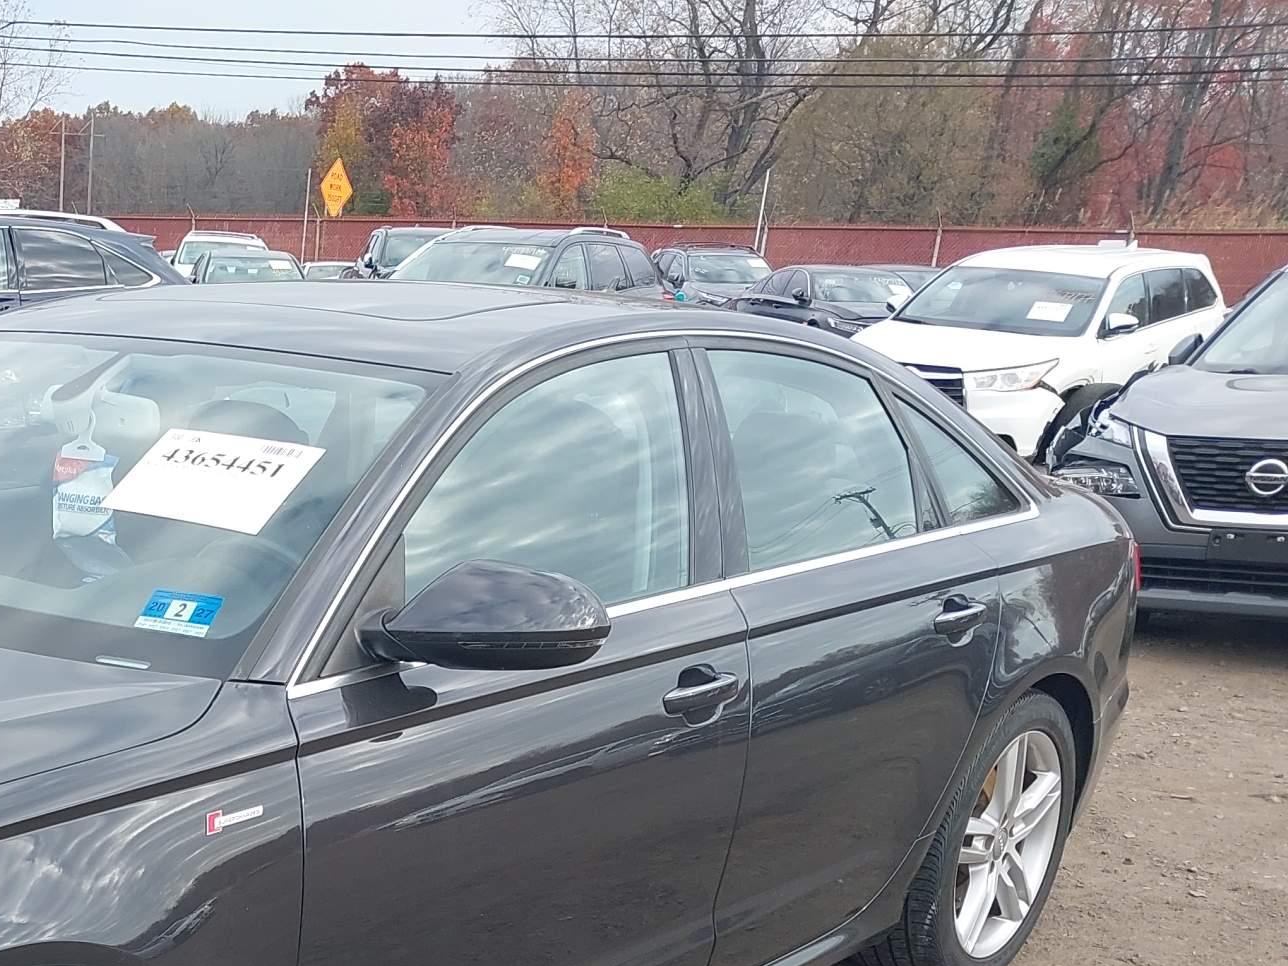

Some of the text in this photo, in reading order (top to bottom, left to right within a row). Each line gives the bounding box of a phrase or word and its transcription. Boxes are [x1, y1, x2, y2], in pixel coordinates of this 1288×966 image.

[161, 447, 285, 478] 43654451
[148, 601, 215, 618] 20 2 27
